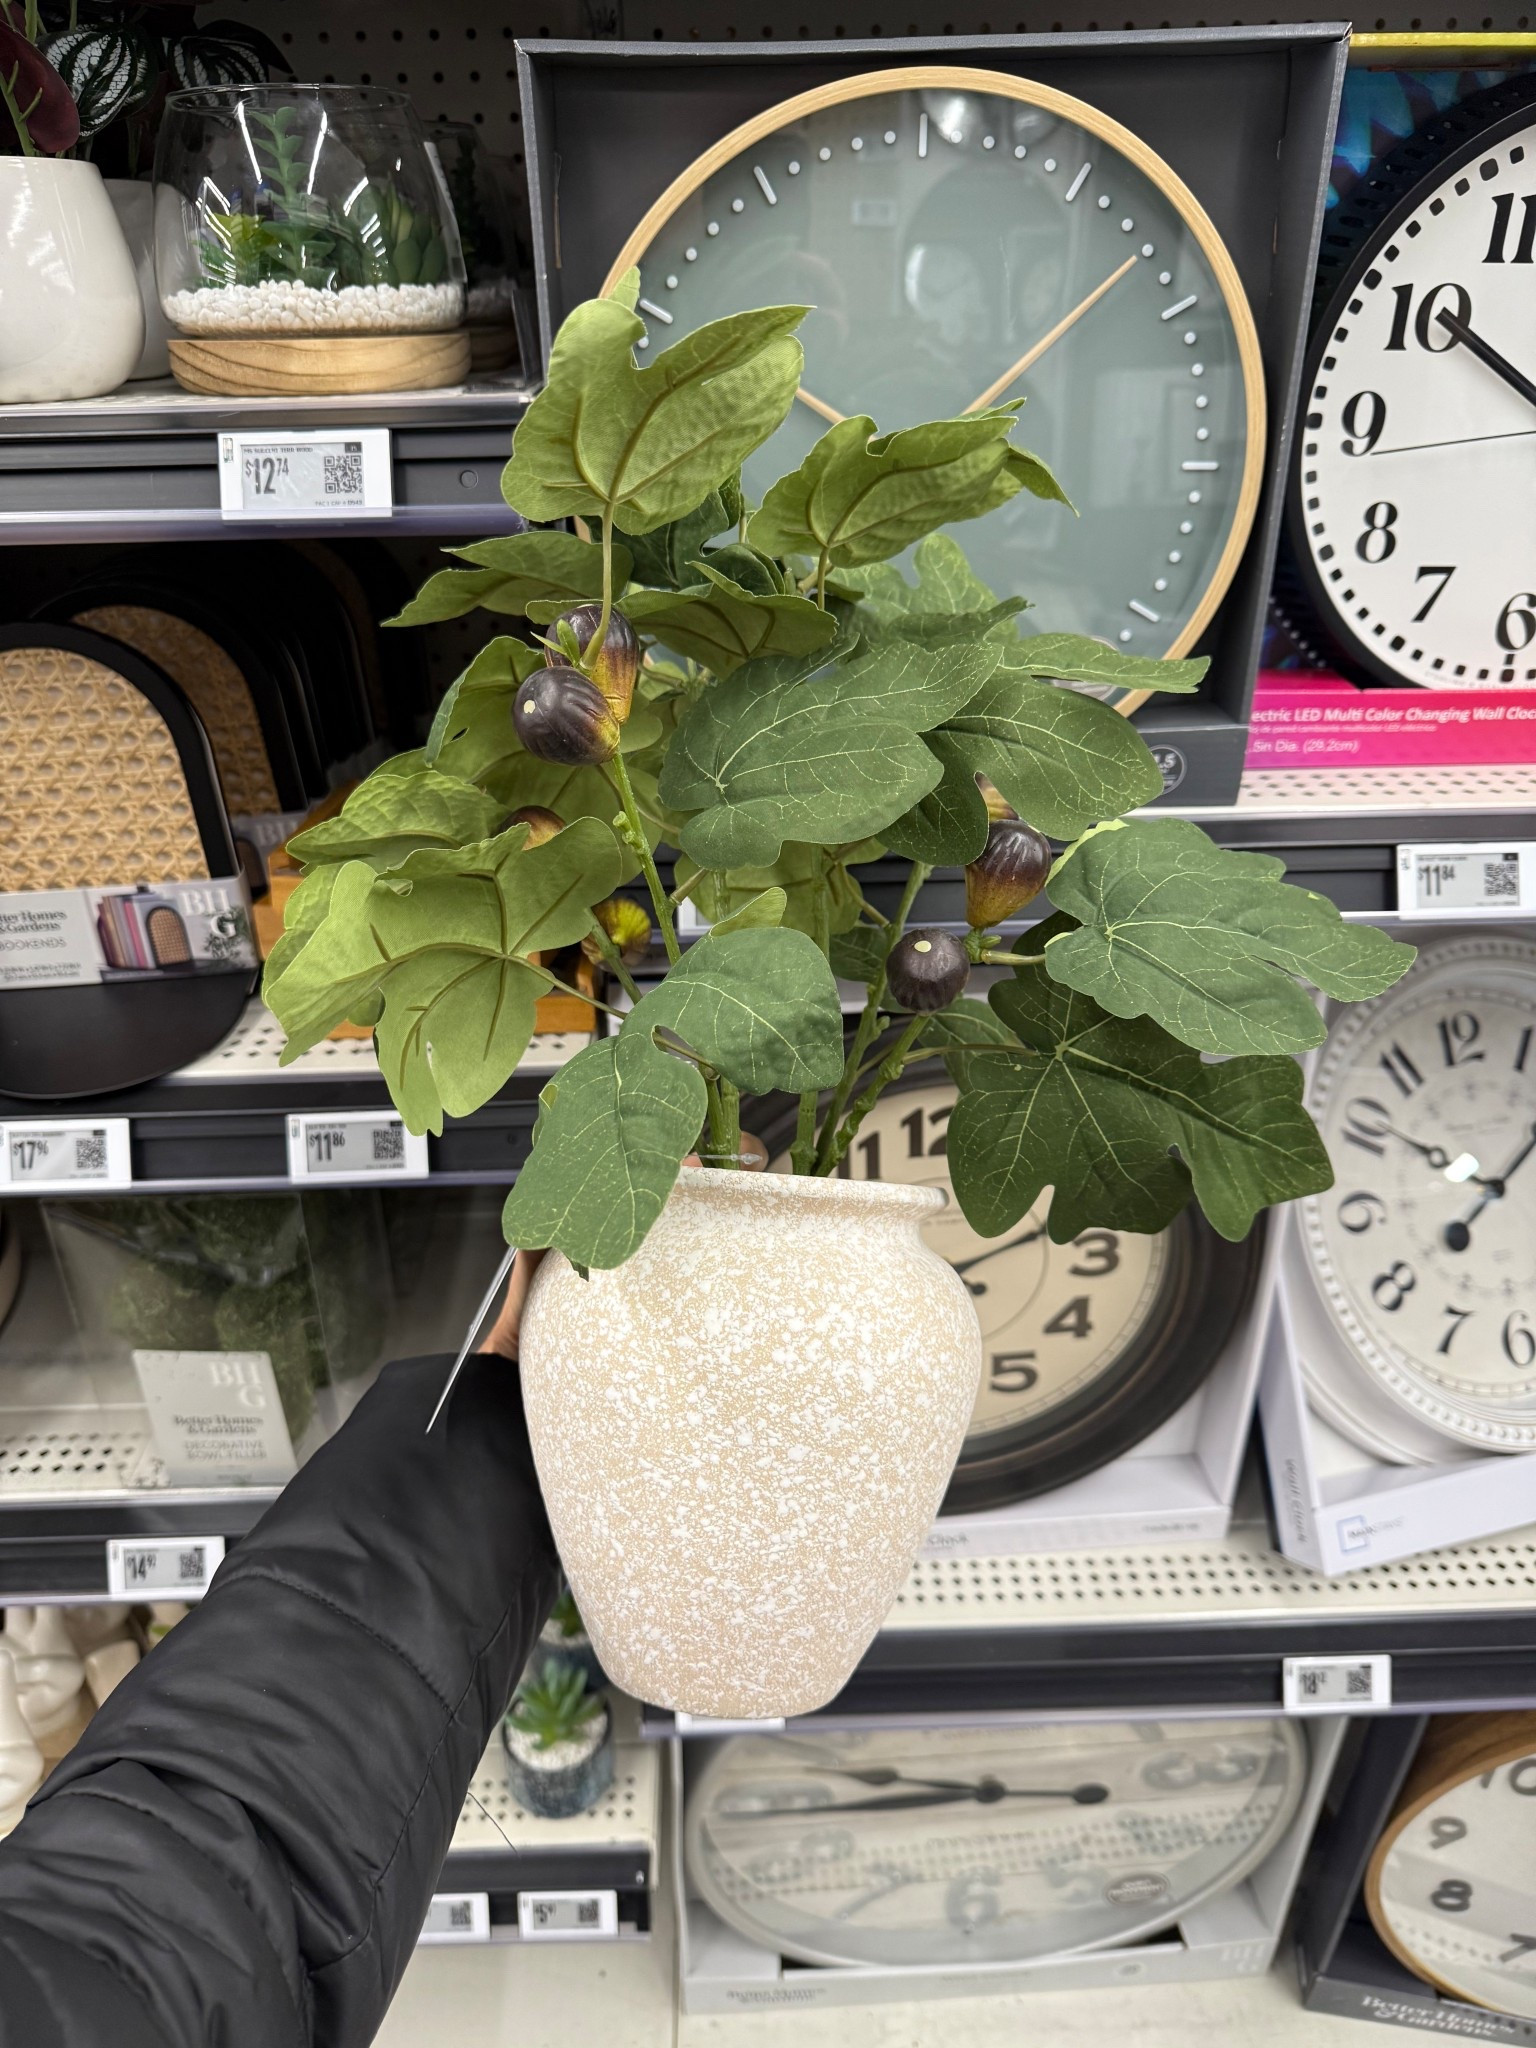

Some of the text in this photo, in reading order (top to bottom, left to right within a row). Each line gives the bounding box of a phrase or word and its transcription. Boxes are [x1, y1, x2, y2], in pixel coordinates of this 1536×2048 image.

[1383, 282, 1472, 353] 10
[1340, 390, 1387, 457] 9
[1355, 501, 1398, 563] 8
[1410, 566, 1457, 623] 7
[1495, 592, 1536, 651] 6
[1294, 708, 1322, 722] LED
[1323, 708, 1365, 722] Multi
[1365, 707, 1405, 722] Color
[1405, 706, 1472, 724] Changing
[1473, 705, 1506, 720] Wall
[1436, 1010, 1488, 1068] 12
[1513, 1025, 1533, 1073] 1
[1381, 1040, 1425, 1098] 11
[1341, 1097, 1392, 1157] 10
[1337, 1190, 1387, 1235] 9
[1068, 1232, 1120, 1277] 3
[1371, 1260, 1417, 1312] 8
[1042, 1294, 1093, 1339] 4
[1436, 1304, 1475, 1356] 7
[1502, 1310, 1536, 1368] 6
[989, 1350, 1038, 1393] 5
[1430, 1817, 1468, 1849] 9
[1430, 1879, 1474, 1913] 8
